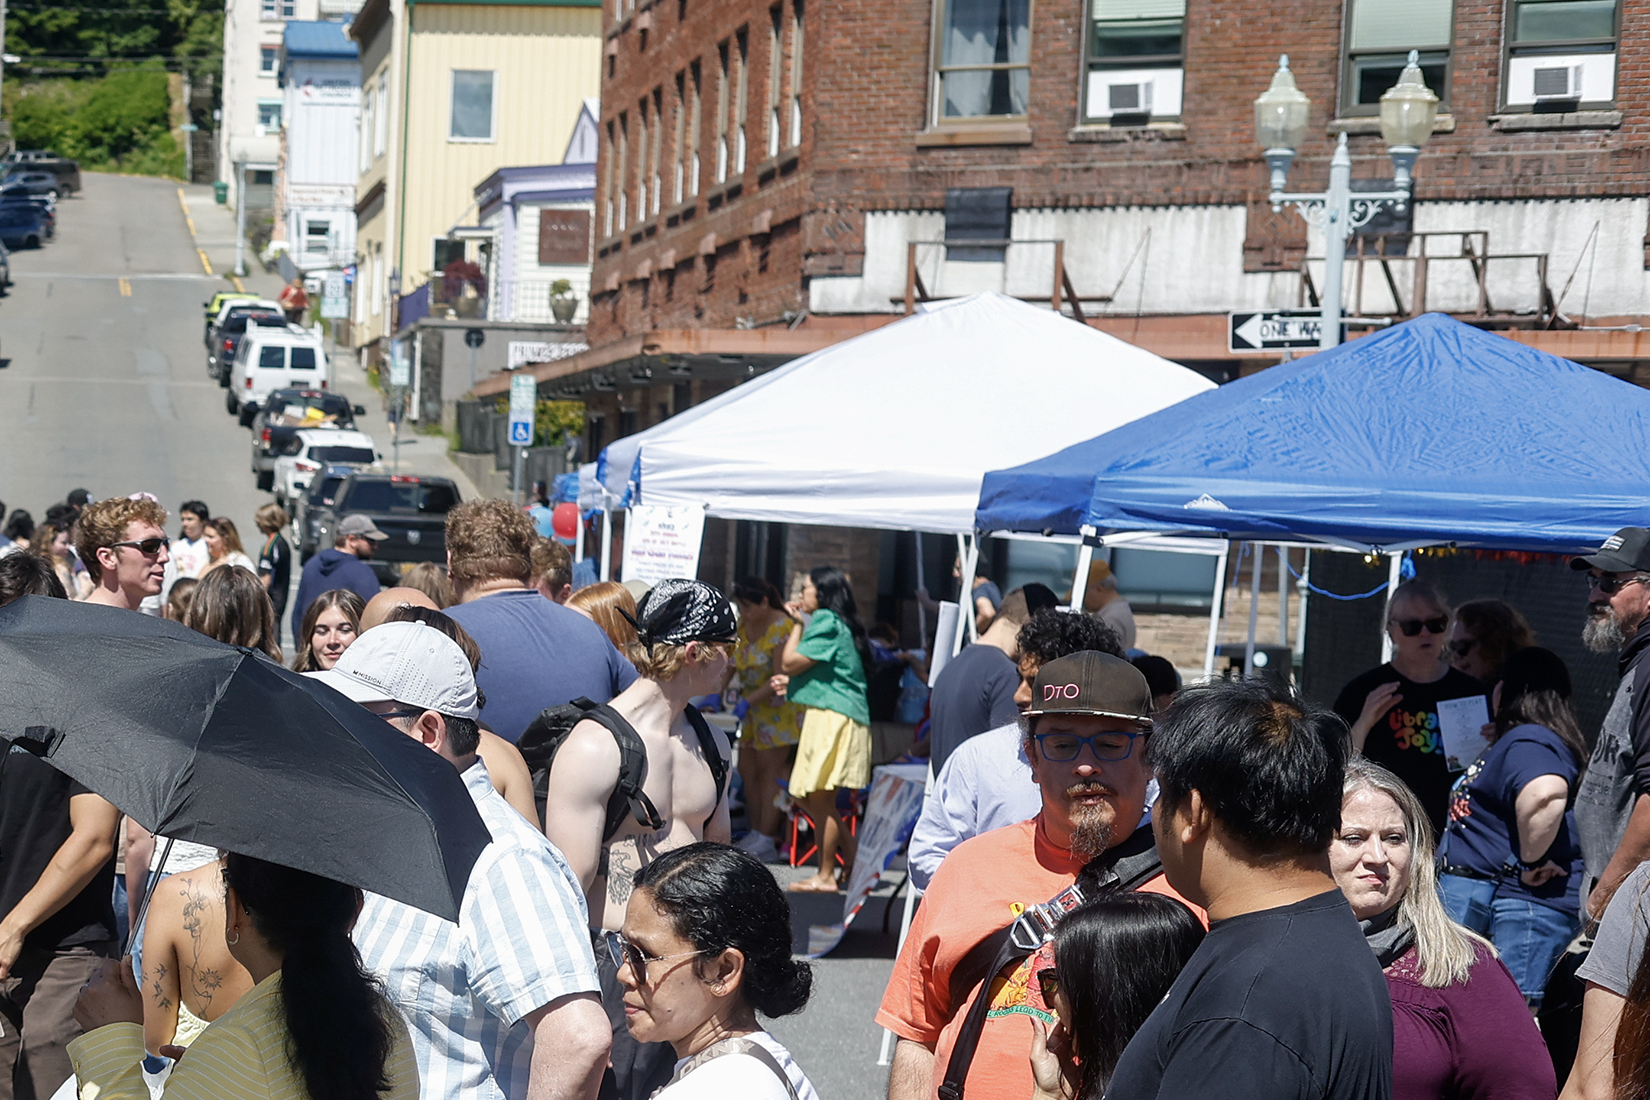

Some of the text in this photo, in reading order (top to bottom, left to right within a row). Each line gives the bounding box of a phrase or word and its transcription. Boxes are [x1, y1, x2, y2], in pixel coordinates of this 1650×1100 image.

[1259, 321, 1321, 337] ONE WA
[358, 672, 382, 685] MISSION
[1389, 708, 1439, 730] Libra
[679, 1038, 756, 1079] DKNY
